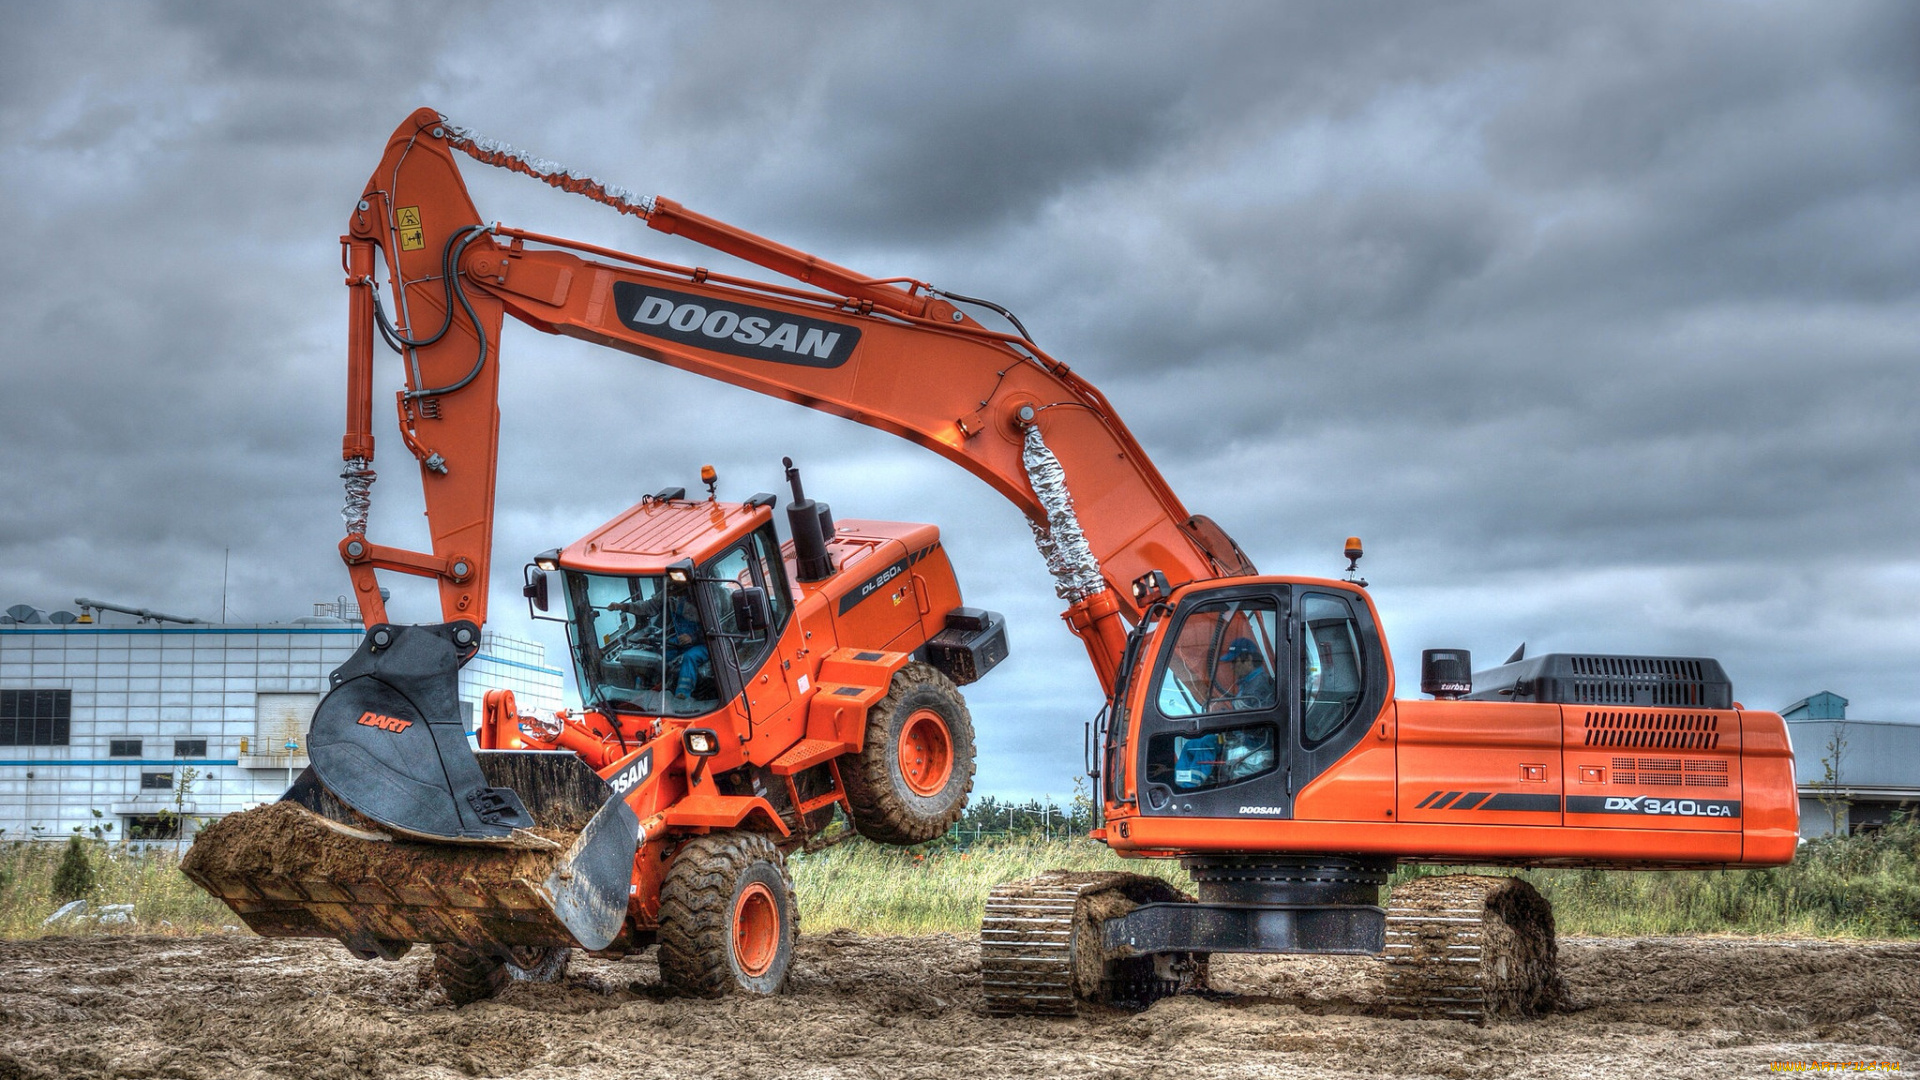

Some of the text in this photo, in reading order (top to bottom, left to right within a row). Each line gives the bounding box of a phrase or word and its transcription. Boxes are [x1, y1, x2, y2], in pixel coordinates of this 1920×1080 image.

[632, 295, 841, 359] DOOSAN
[862, 582, 876, 596] DL
[1441, 682, 1464, 691] turbo
[357, 711, 413, 734] DART
[1239, 806, 1282, 815] DOOSAN
